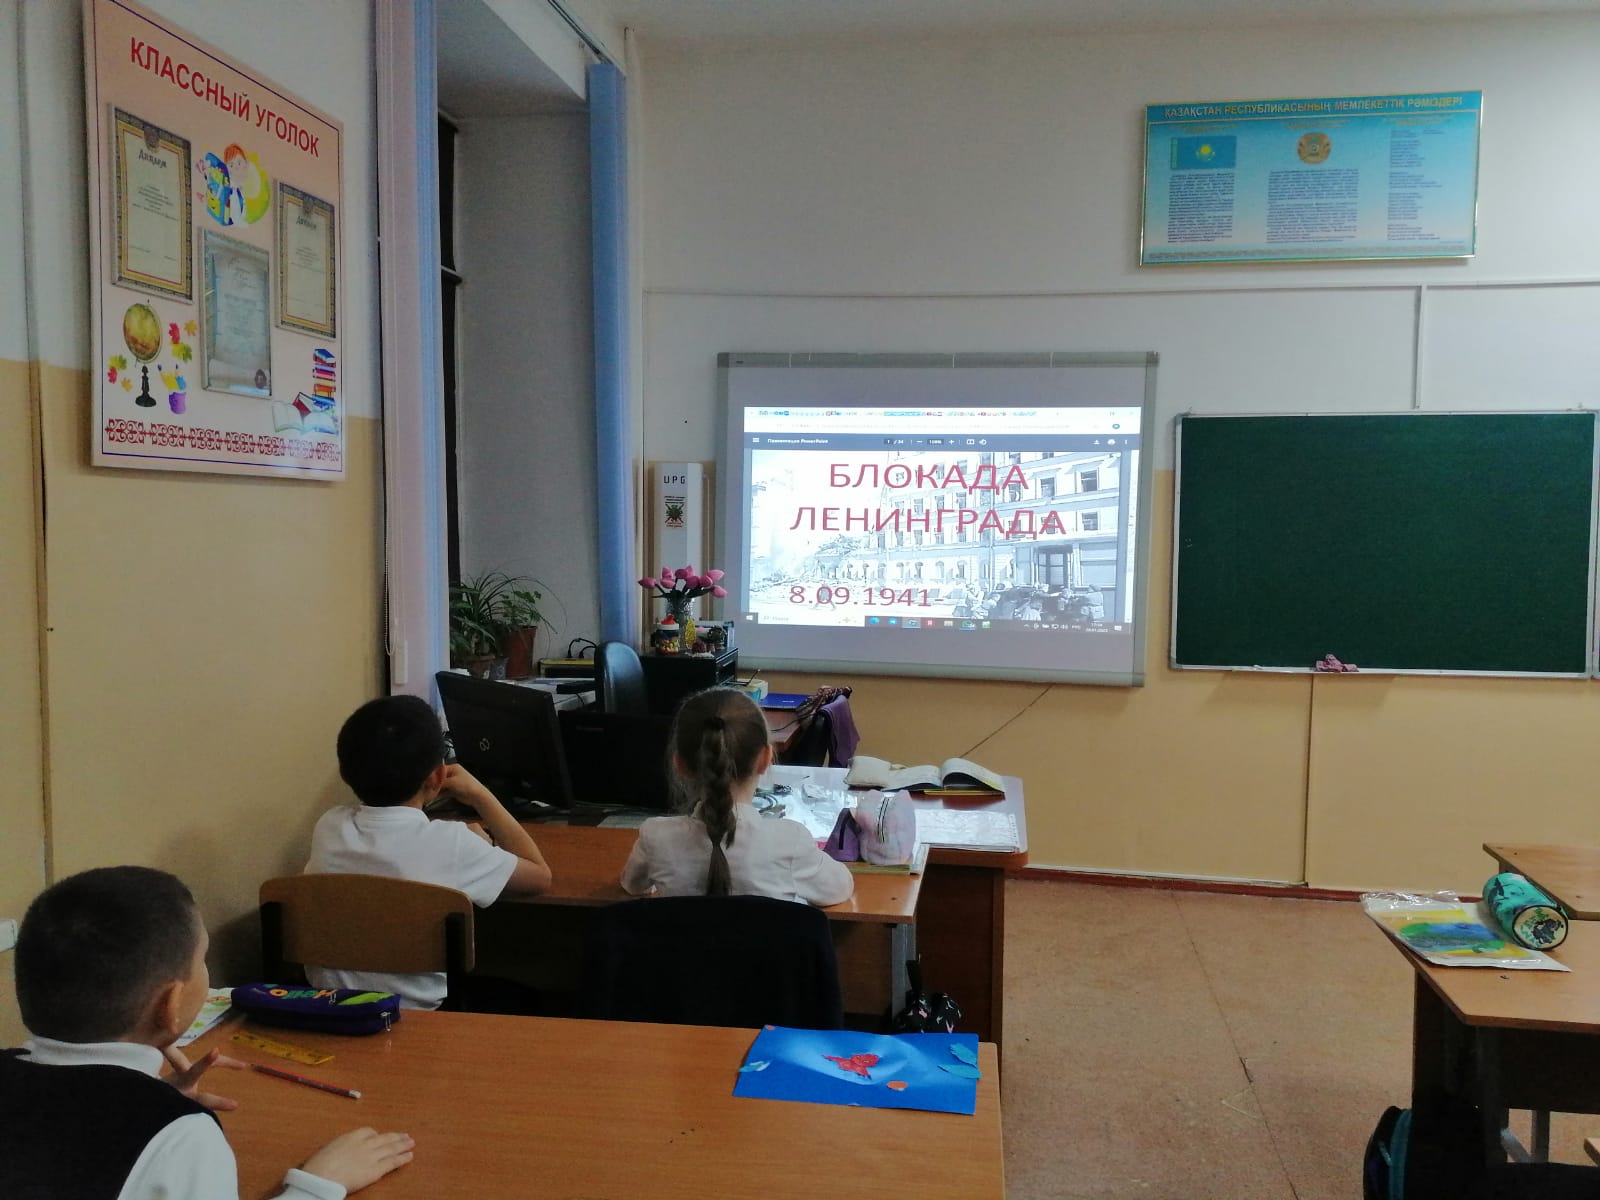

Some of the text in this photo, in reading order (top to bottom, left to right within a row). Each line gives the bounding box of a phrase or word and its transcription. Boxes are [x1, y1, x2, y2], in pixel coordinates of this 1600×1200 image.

[130, 37, 319, 157] КЛАССНЫЙ УГОЛОК
[1165, 106, 1221, 118] ҚАЗАҚСТАН
[1224, 102, 1331, 115] РЕСПУБЛИКАСЫНЫҢ
[830, 463, 1029, 495] БЛОКАДА
[789, 507, 1067, 540] ЛЕНИНГРАДА
